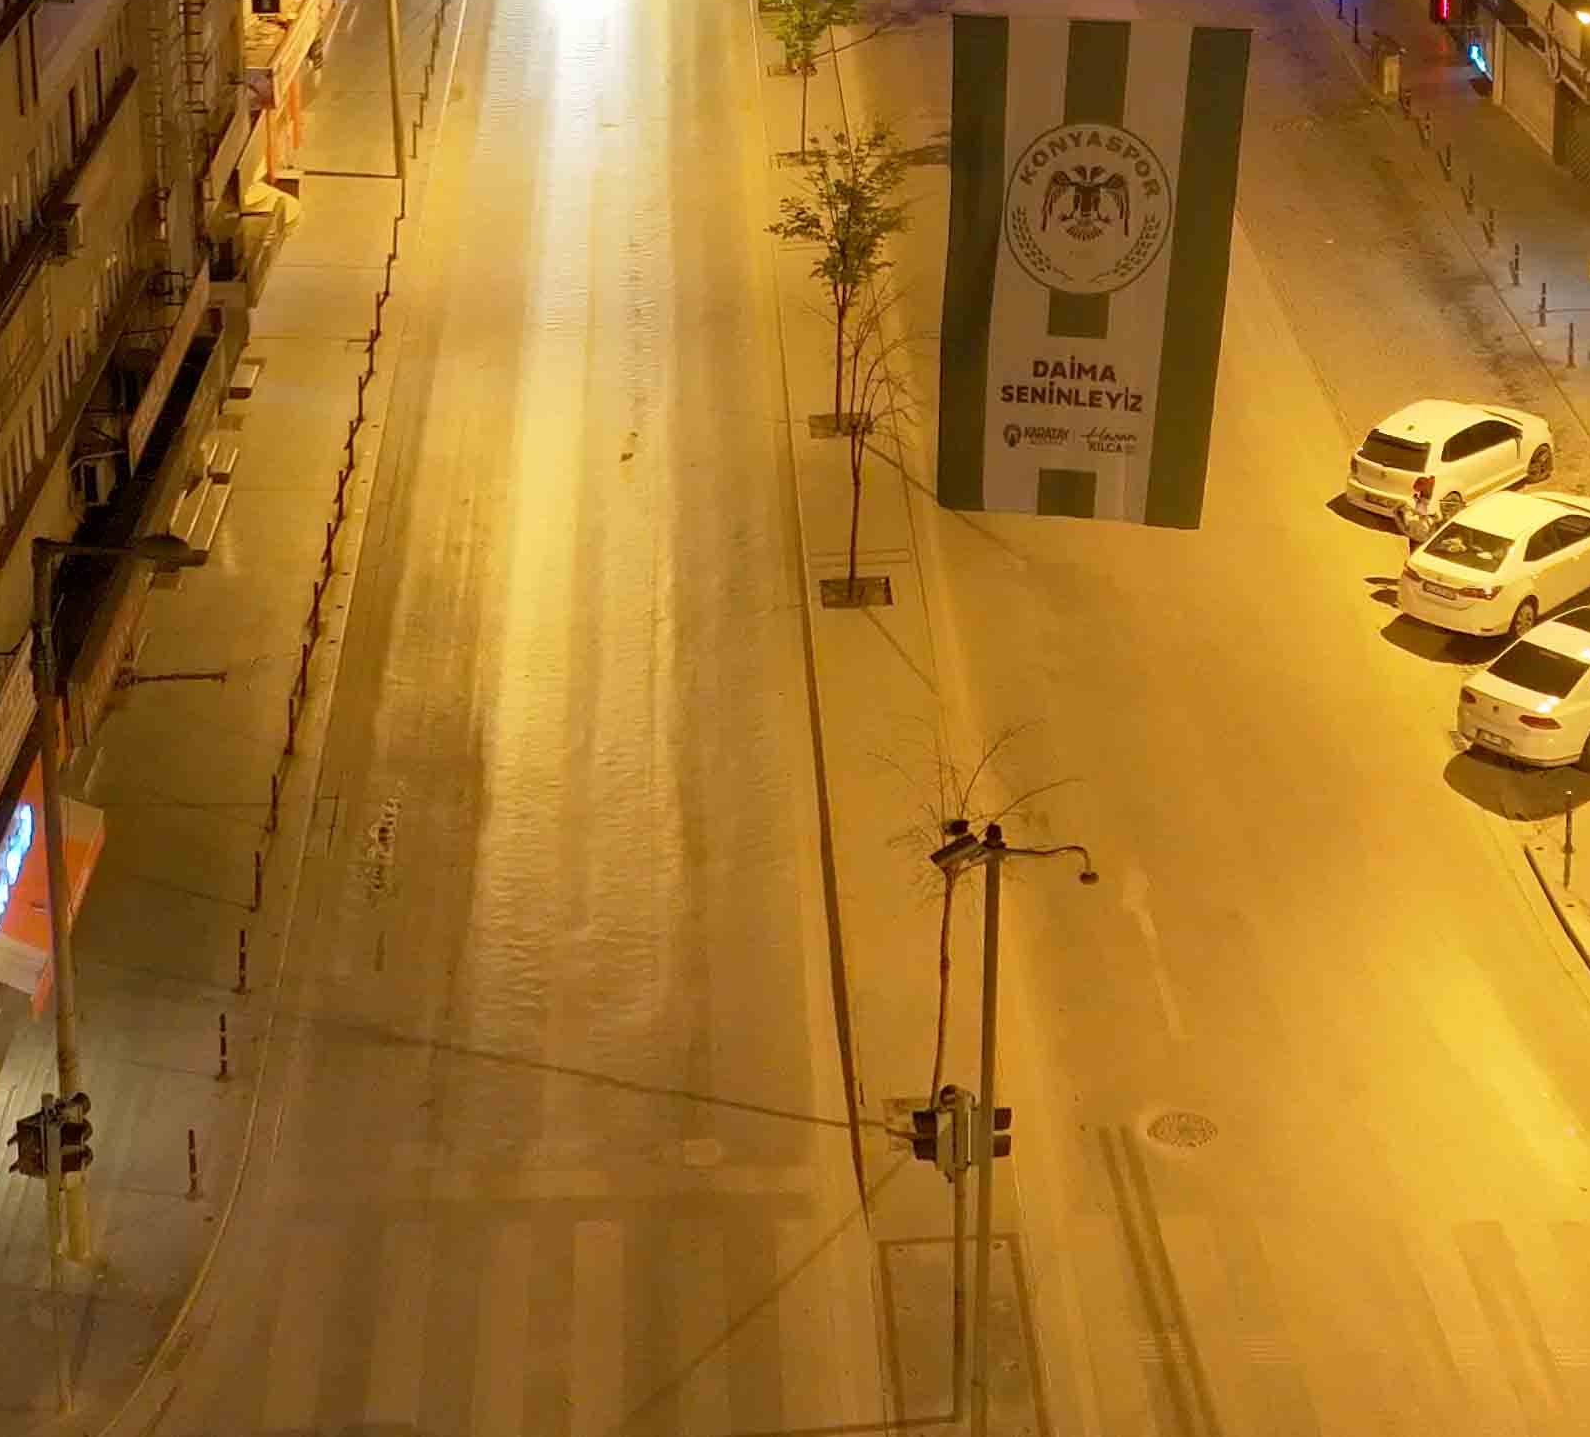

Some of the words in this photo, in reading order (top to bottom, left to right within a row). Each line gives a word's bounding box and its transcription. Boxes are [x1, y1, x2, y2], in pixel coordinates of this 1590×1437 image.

[1019, 130, 1160, 197] KONYASPOR
[1031, 354, 1117, 384] DAİMA
[999, 381, 1144, 413] SENİNLEYİZ
